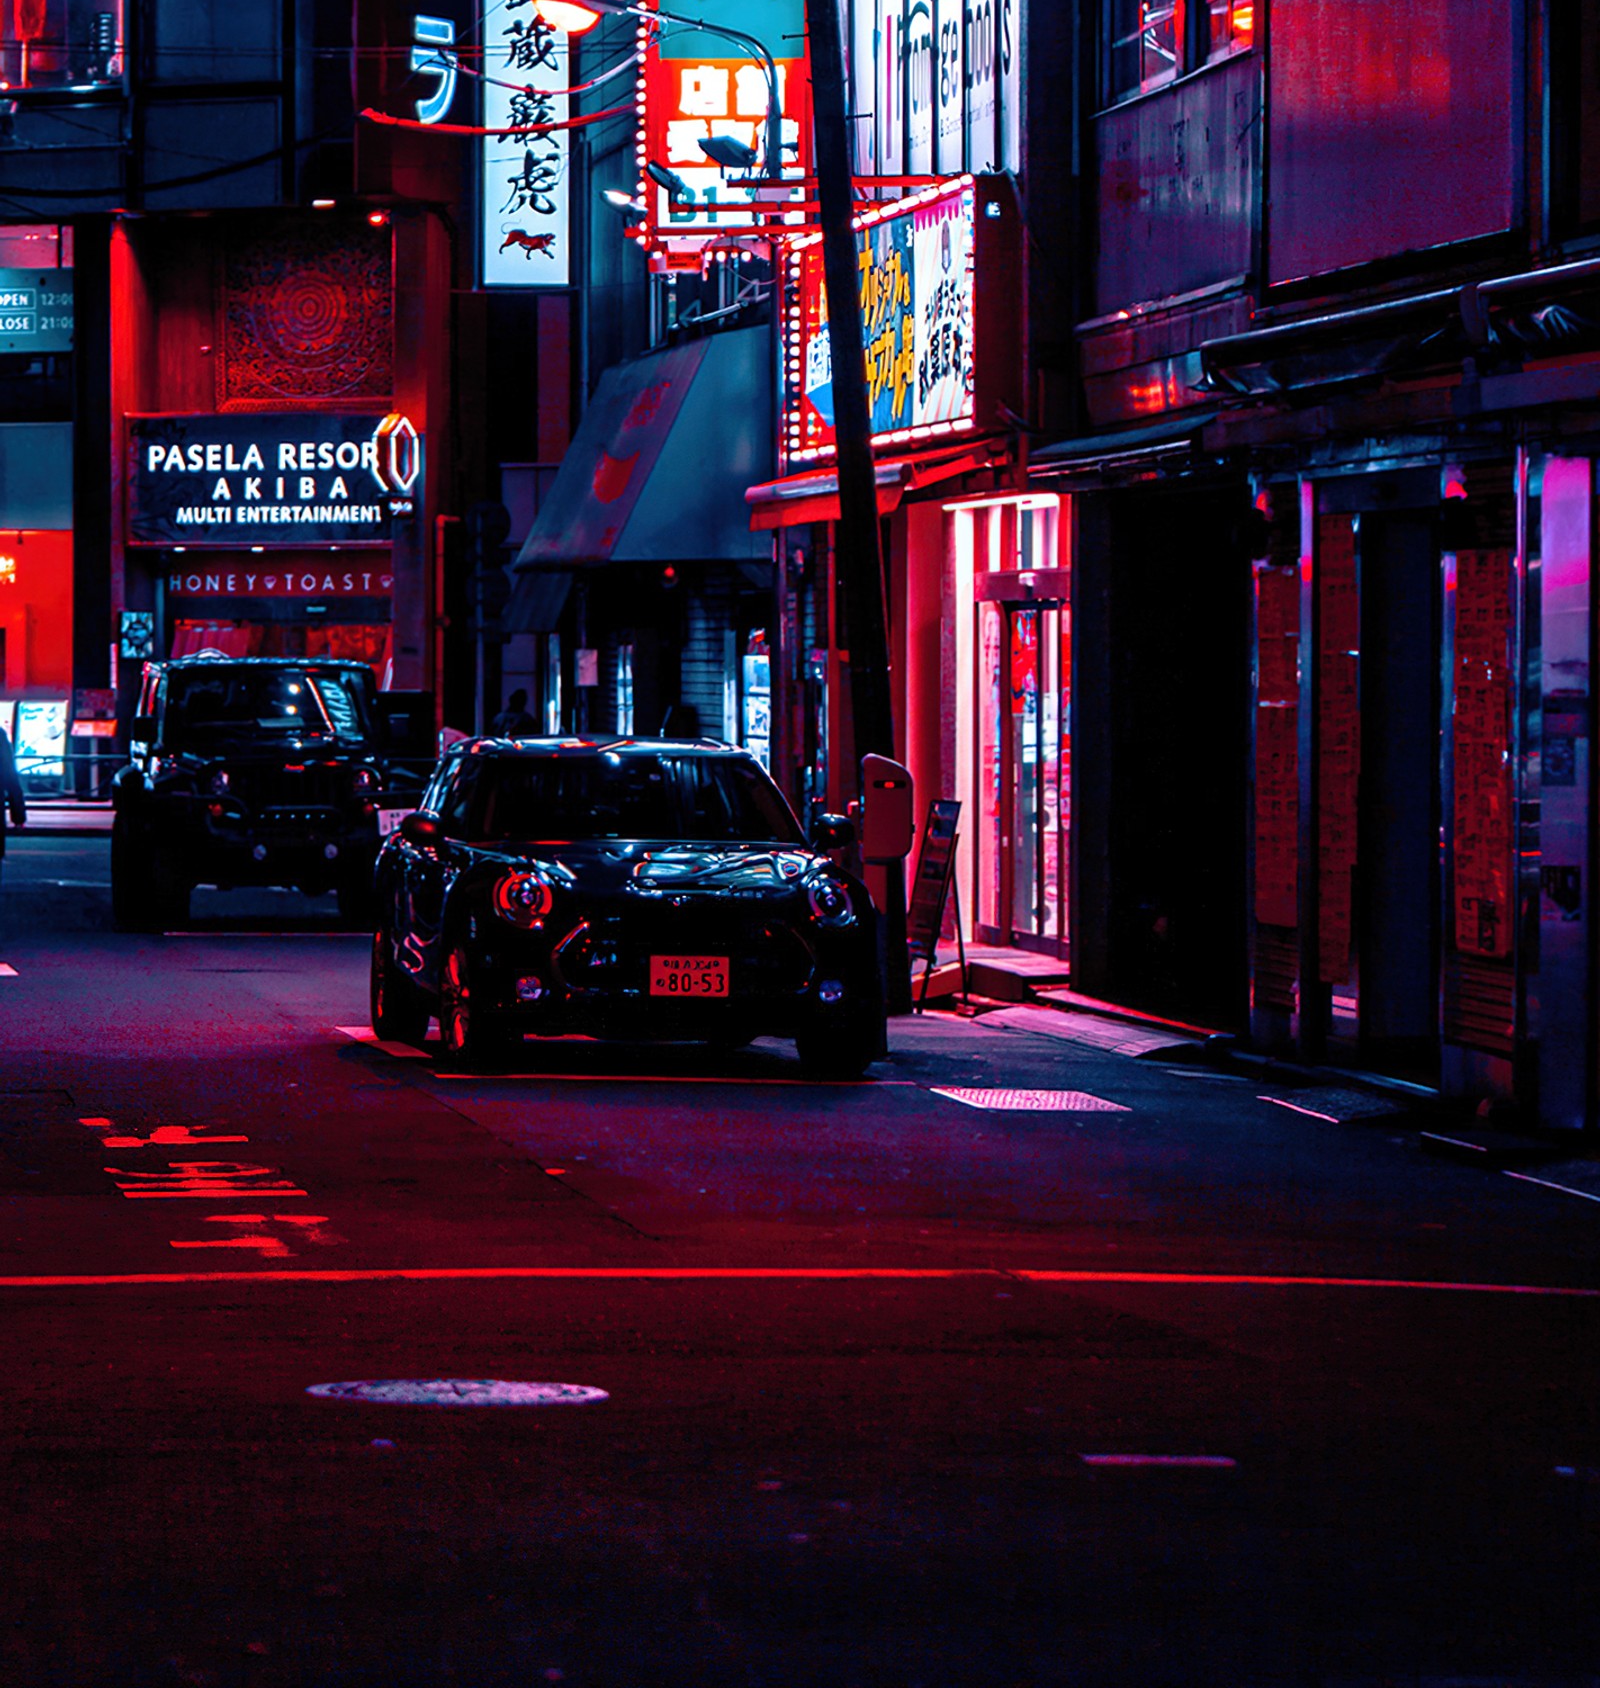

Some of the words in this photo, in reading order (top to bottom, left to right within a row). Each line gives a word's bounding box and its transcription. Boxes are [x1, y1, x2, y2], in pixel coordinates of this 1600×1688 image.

[148, 443, 264, 472] PASELA
[278, 441, 379, 470] RESOR
[212, 476, 348, 500] AKIBA
[175, 507, 231, 524] MULTI
[169, 574, 256, 592] HONEY
[284, 573, 371, 591] TOAST
[668, 972, 725, 993] 80-53
